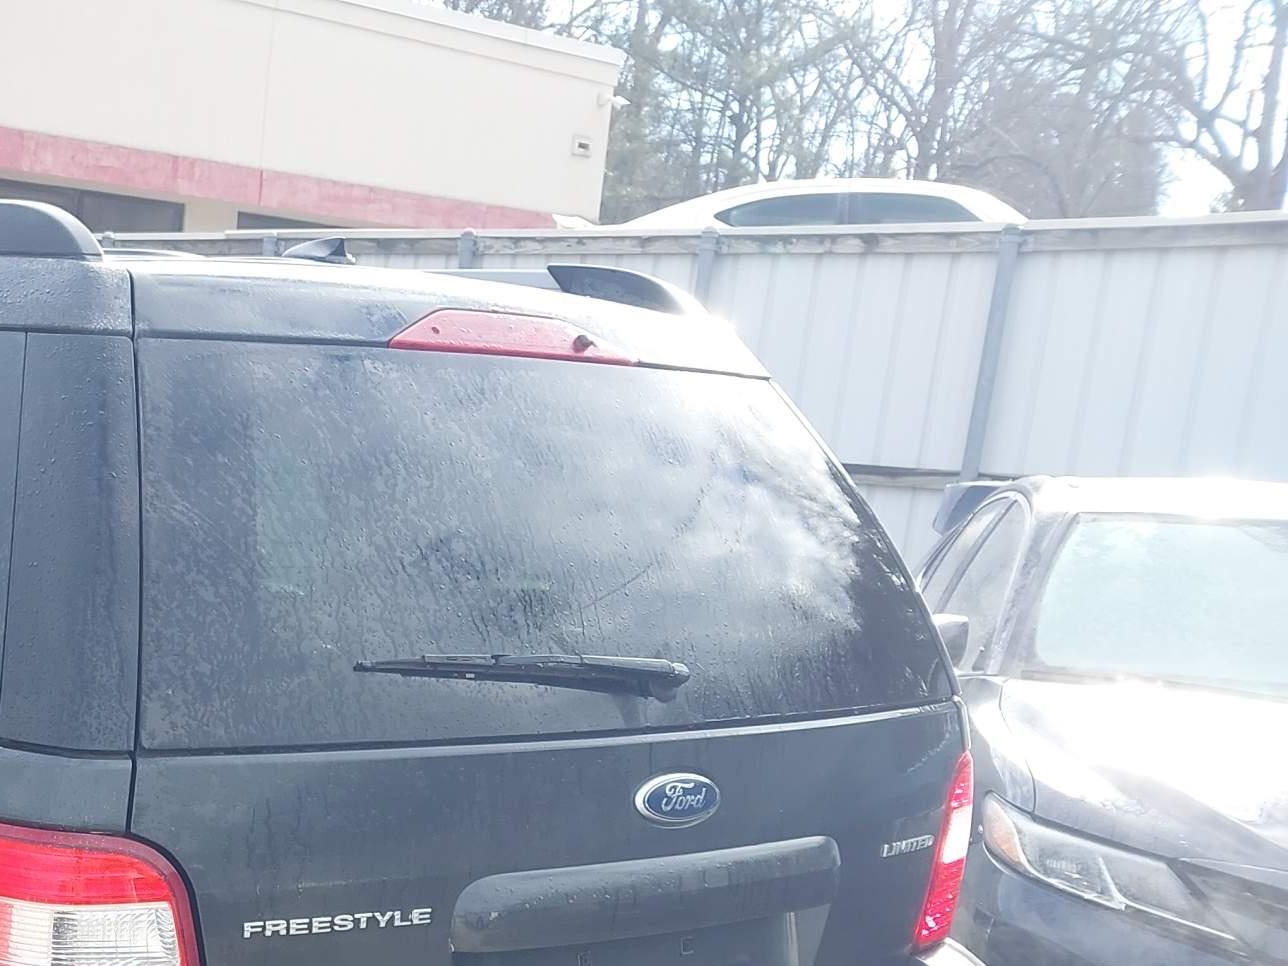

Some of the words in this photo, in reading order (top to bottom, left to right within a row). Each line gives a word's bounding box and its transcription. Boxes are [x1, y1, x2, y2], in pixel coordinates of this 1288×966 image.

[661, 782, 707, 812] Ford
[880, 834, 935, 858] LIMITED
[242, 907, 433, 939] FREESTYLE
